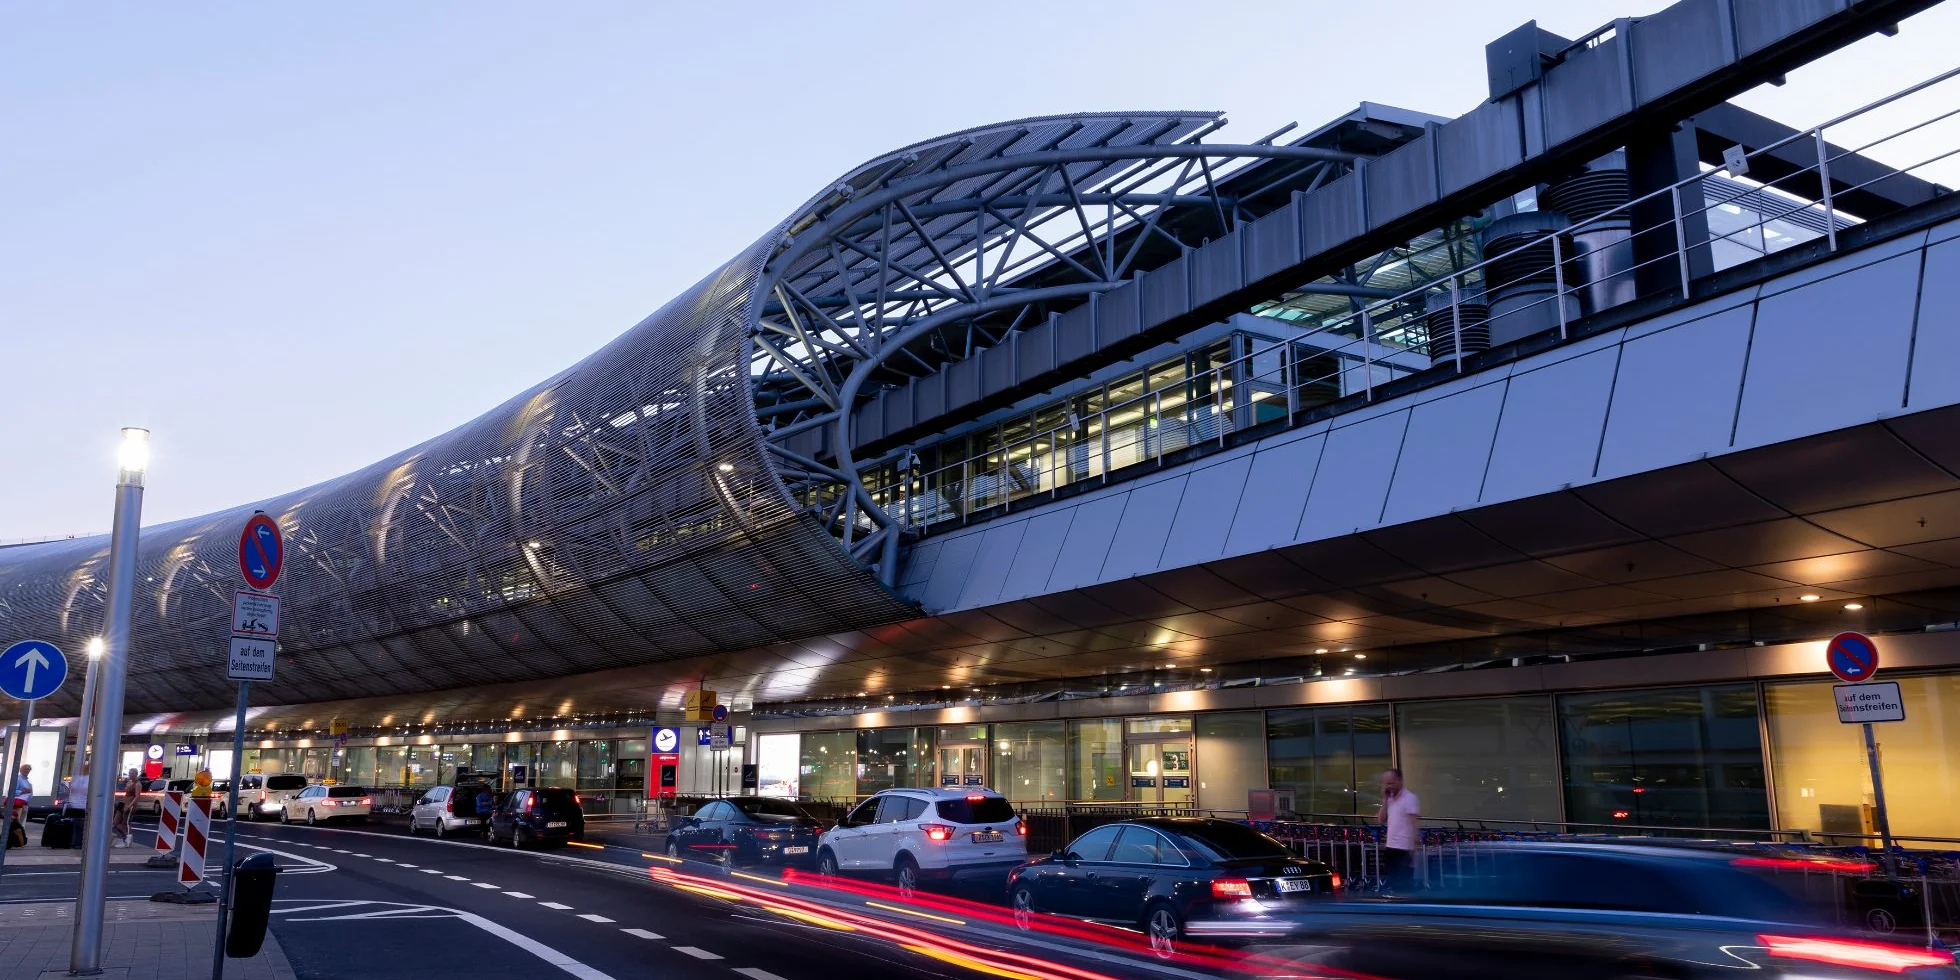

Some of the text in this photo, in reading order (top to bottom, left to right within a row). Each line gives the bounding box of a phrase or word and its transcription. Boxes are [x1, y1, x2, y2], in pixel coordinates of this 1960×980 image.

[240, 646, 265, 658] auf dem
[231, 660, 271, 673] Seitenstreifen
[1859, 693, 1881, 701] dem
[1172, 754, 1179, 771] 3
